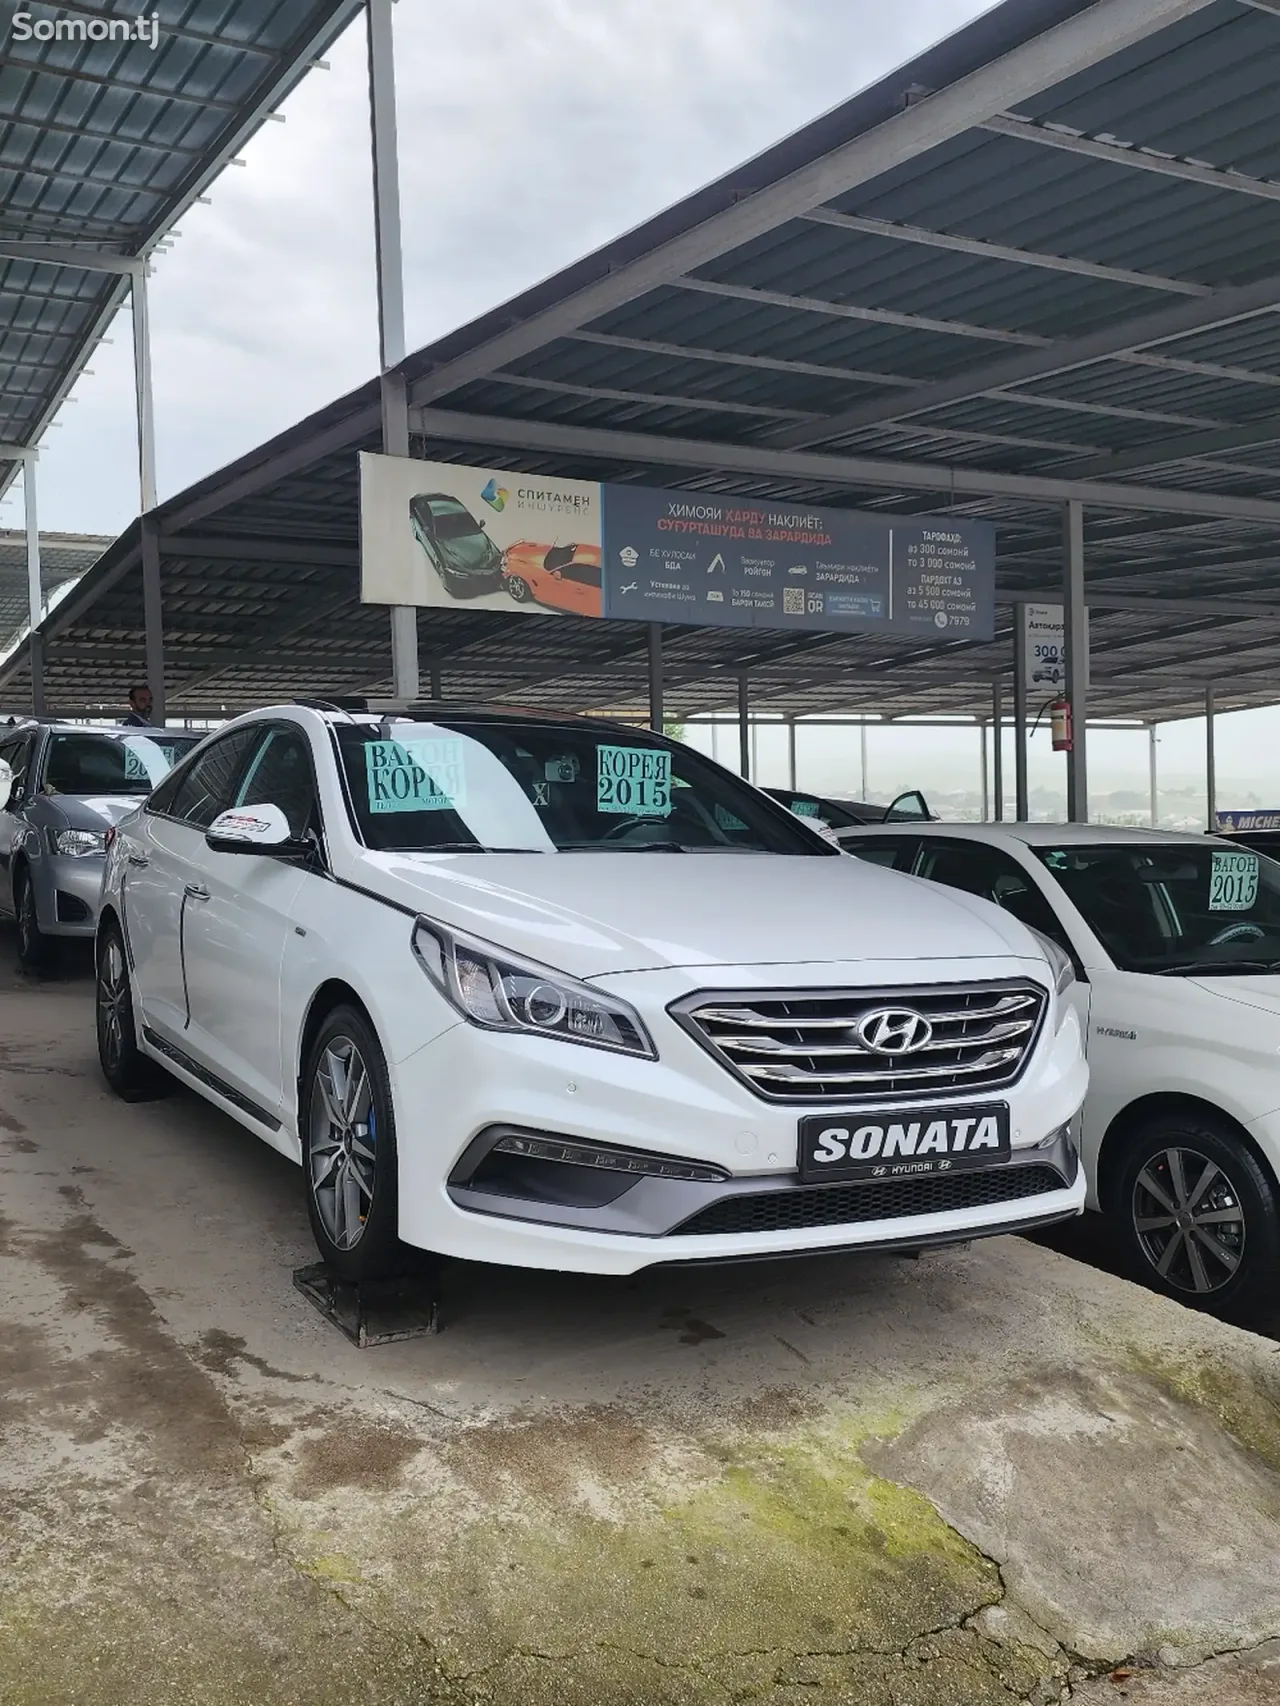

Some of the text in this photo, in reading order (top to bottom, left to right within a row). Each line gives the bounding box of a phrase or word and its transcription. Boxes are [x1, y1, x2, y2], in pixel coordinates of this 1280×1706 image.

[517, 488, 591, 506] СПИТАМЕН
[517, 501, 590, 516] ИНШУРЕНС
[748, 529, 763, 540] ВА
[765, 530, 832, 546] ЗАРАРДИДА
[907, 544, 918, 554] аз
[919, 543, 936, 555] 300
[665, 561, 681, 571] БДА
[907, 558, 918, 567] то
[919, 557, 925, 568] 3
[815, 572, 860, 584] ЗАРАРДИДА
[906, 586, 917, 595] аз
[918, 585, 924, 595] 5
[807, 599, 824, 614] QR
[906, 600, 917, 609] то
[918, 599, 929, 609] 45
[948, 615, 970, 626] 7979
[1033, 644, 1058, 657] 300
[598, 750, 668, 780] КОРЕЯ
[599, 777, 668, 807] 2015
[1213, 856, 1257, 873] ВАГОН
[1212, 874, 1258, 904] 2015
[813, 1116, 1000, 1163] SONATA
[891, 1163, 933, 1175] HYUNDAI
